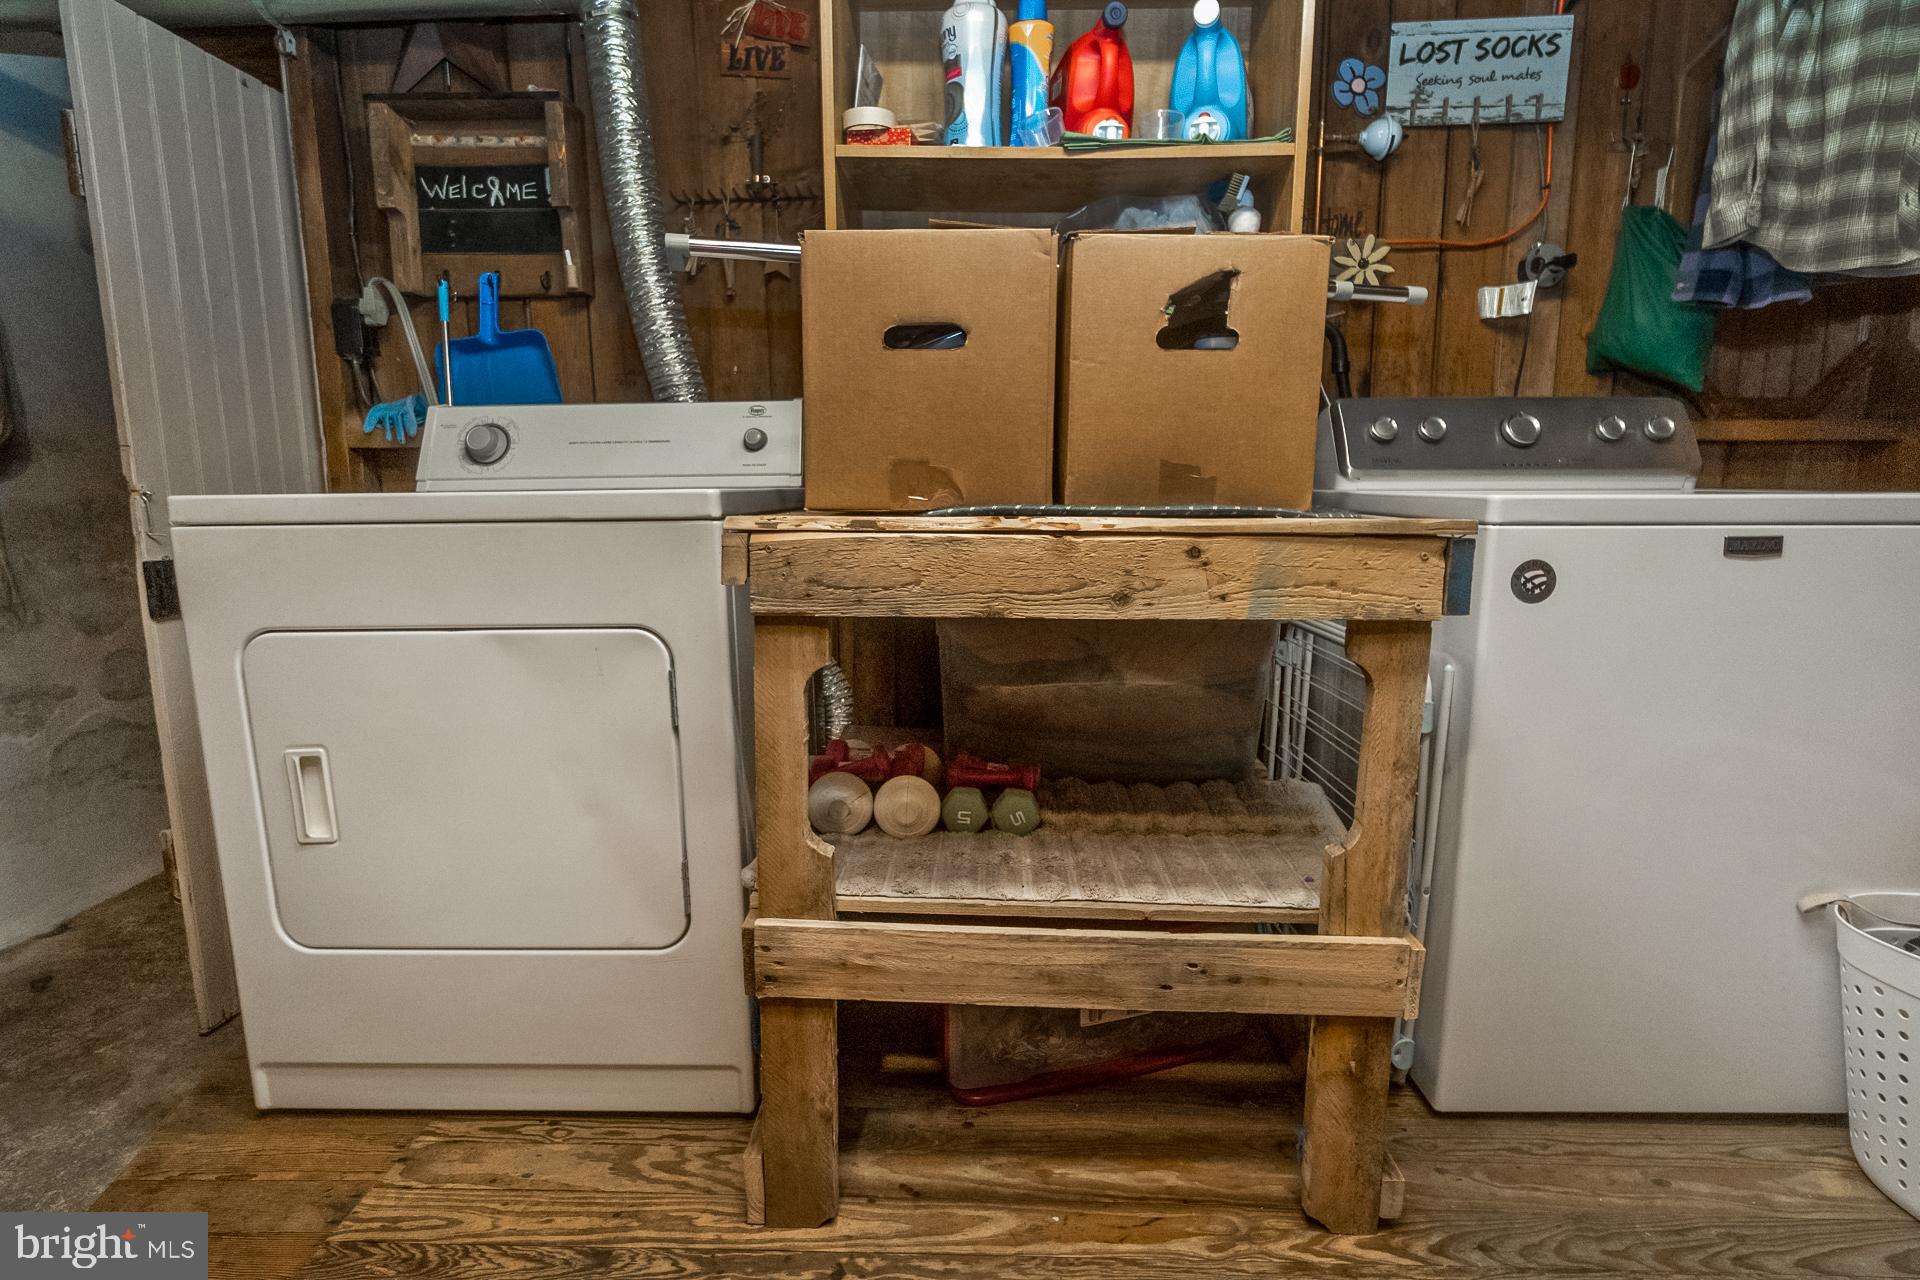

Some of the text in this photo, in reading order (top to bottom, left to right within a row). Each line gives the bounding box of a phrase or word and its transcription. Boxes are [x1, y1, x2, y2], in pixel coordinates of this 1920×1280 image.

[727, 44, 786, 71] LIVE
[1399, 32, 1563, 66] LOST SOCKS
[1415, 67, 1543, 89] Seeking soul mates
[956, 810, 972, 824] 5
